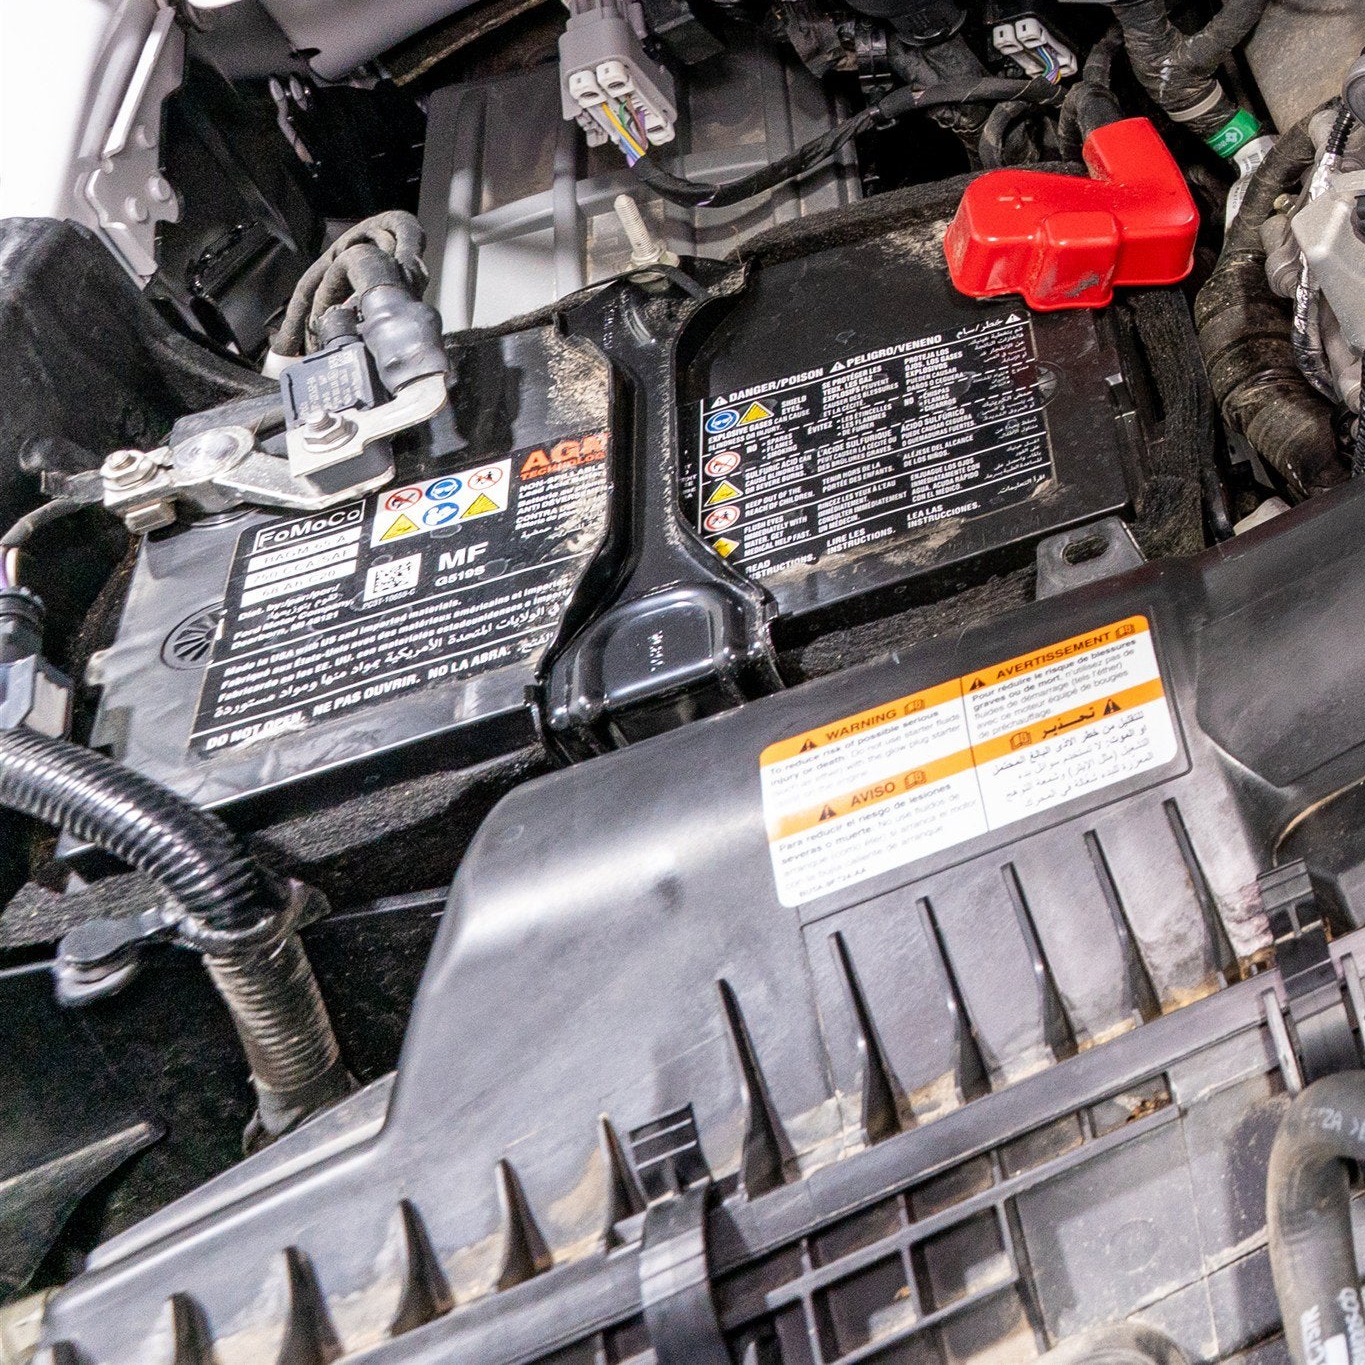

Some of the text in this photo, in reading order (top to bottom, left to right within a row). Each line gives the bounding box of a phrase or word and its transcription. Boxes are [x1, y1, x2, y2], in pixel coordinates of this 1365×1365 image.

[729, 367, 823, 402] DANGER/POISON
[846, 333, 941, 367] PELIGRO/VENENO
[904, 350, 962, 372] OJOS. LOS GASES
[905, 361, 947, 378] EXPLOSIVOS
[822, 364, 881, 389] SE PROTÉGER LES
[923, 386, 949, 399] CHISPAS
[923, 393, 949, 405] FLAMAS
[924, 397, 956, 411] CIGARROS
[781, 403, 802, 415] EYES.
[841, 402, 892, 423] LES ÉTINCELLES
[841, 411, 886, 429] LES FLAMMES
[900, 407, 964, 432] ÁCIDO SULFÚRICO
[708, 408, 809, 444] EXPLOSIVE GASES CAN CAUSE
[807, 419, 832, 435] ÉVITEZ
[852, 421, 874, 432] FUMER
[746, 443, 757, 453] NO
[766, 438, 792, 451] FLAMES
[767, 444, 797, 459] SMOKING
[817, 428, 892, 457] L'ACIDE SULFURIQUE
[902, 434, 973, 460] ALÉJESE DEL ALCANCE
[822, 464, 894, 493] PORTÉE DES ENFANTS.
[745, 486, 801, 509] KEEP OUT OF THE
[745, 489, 815, 517] REACH OF CHILDREN.
[907, 504, 942, 521] LEA LAS
[907, 500, 981, 528] INSTRUCCIONES.
[258, 505, 361, 548] FoMoCo
[744, 515, 807, 541] IMMEDIATELY WITH
[826, 527, 865, 547] LIRE LES
[744, 530, 783, 549] WATER. GET
[744, 529, 811, 556] MEDICAL HELP FAST.
[827, 525, 896, 554] INSTRUCTIONS.
[437, 540, 488, 572] MF
[746, 559, 770, 574] READ
[232, 596, 355, 640] Ford Motor Company,
[223, 596, 462, 677] Made in USA with US and imported materials.
[971, 637, 1136, 702] Pour réduire le risque de blessures
[205, 643, 512, 750] DO NOT OPEN. NE PAS OUVRIR. NO LA ABRA.
[826, 631, 1112, 741] WARNING AVERTISSEMENT
[770, 709, 939, 775] To reduce risk of possible serious
[849, 780, 896, 807] AVISO
[779, 782, 950, 852] Para reducir el riesgo de lesiones
